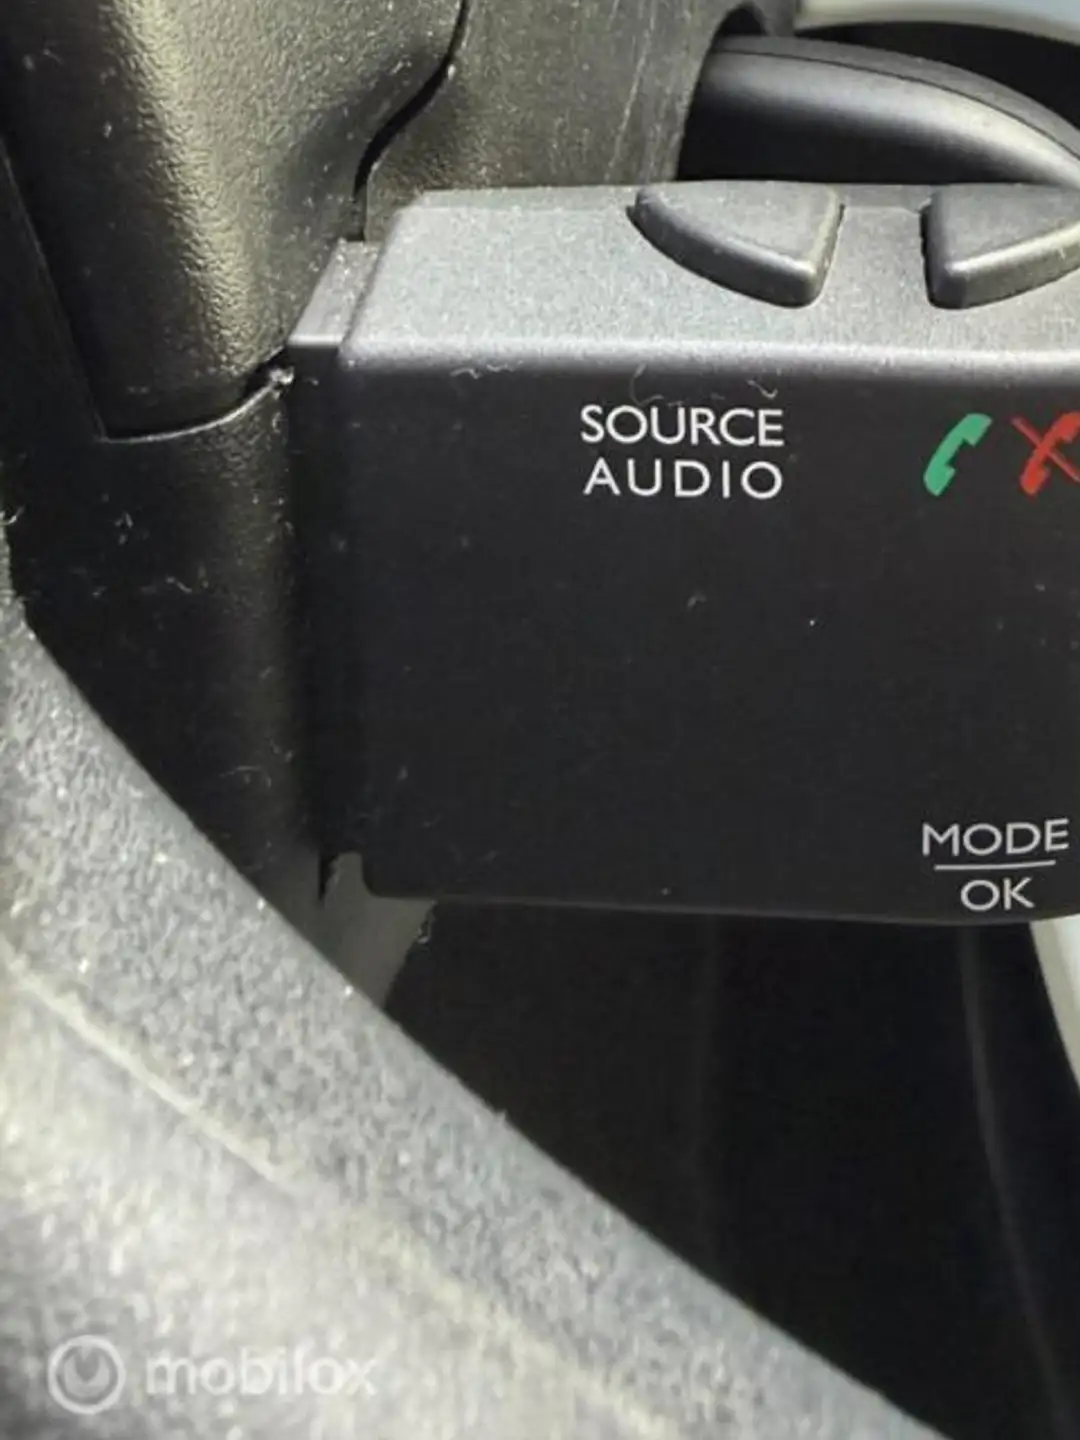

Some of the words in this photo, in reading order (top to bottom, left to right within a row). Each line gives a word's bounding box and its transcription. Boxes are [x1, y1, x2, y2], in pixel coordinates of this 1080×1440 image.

[580, 404, 784, 447] SOURCE
[583, 459, 783, 499] AUDIO
[921, 818, 1070, 858] MODE
[960, 878, 1036, 910] OK
